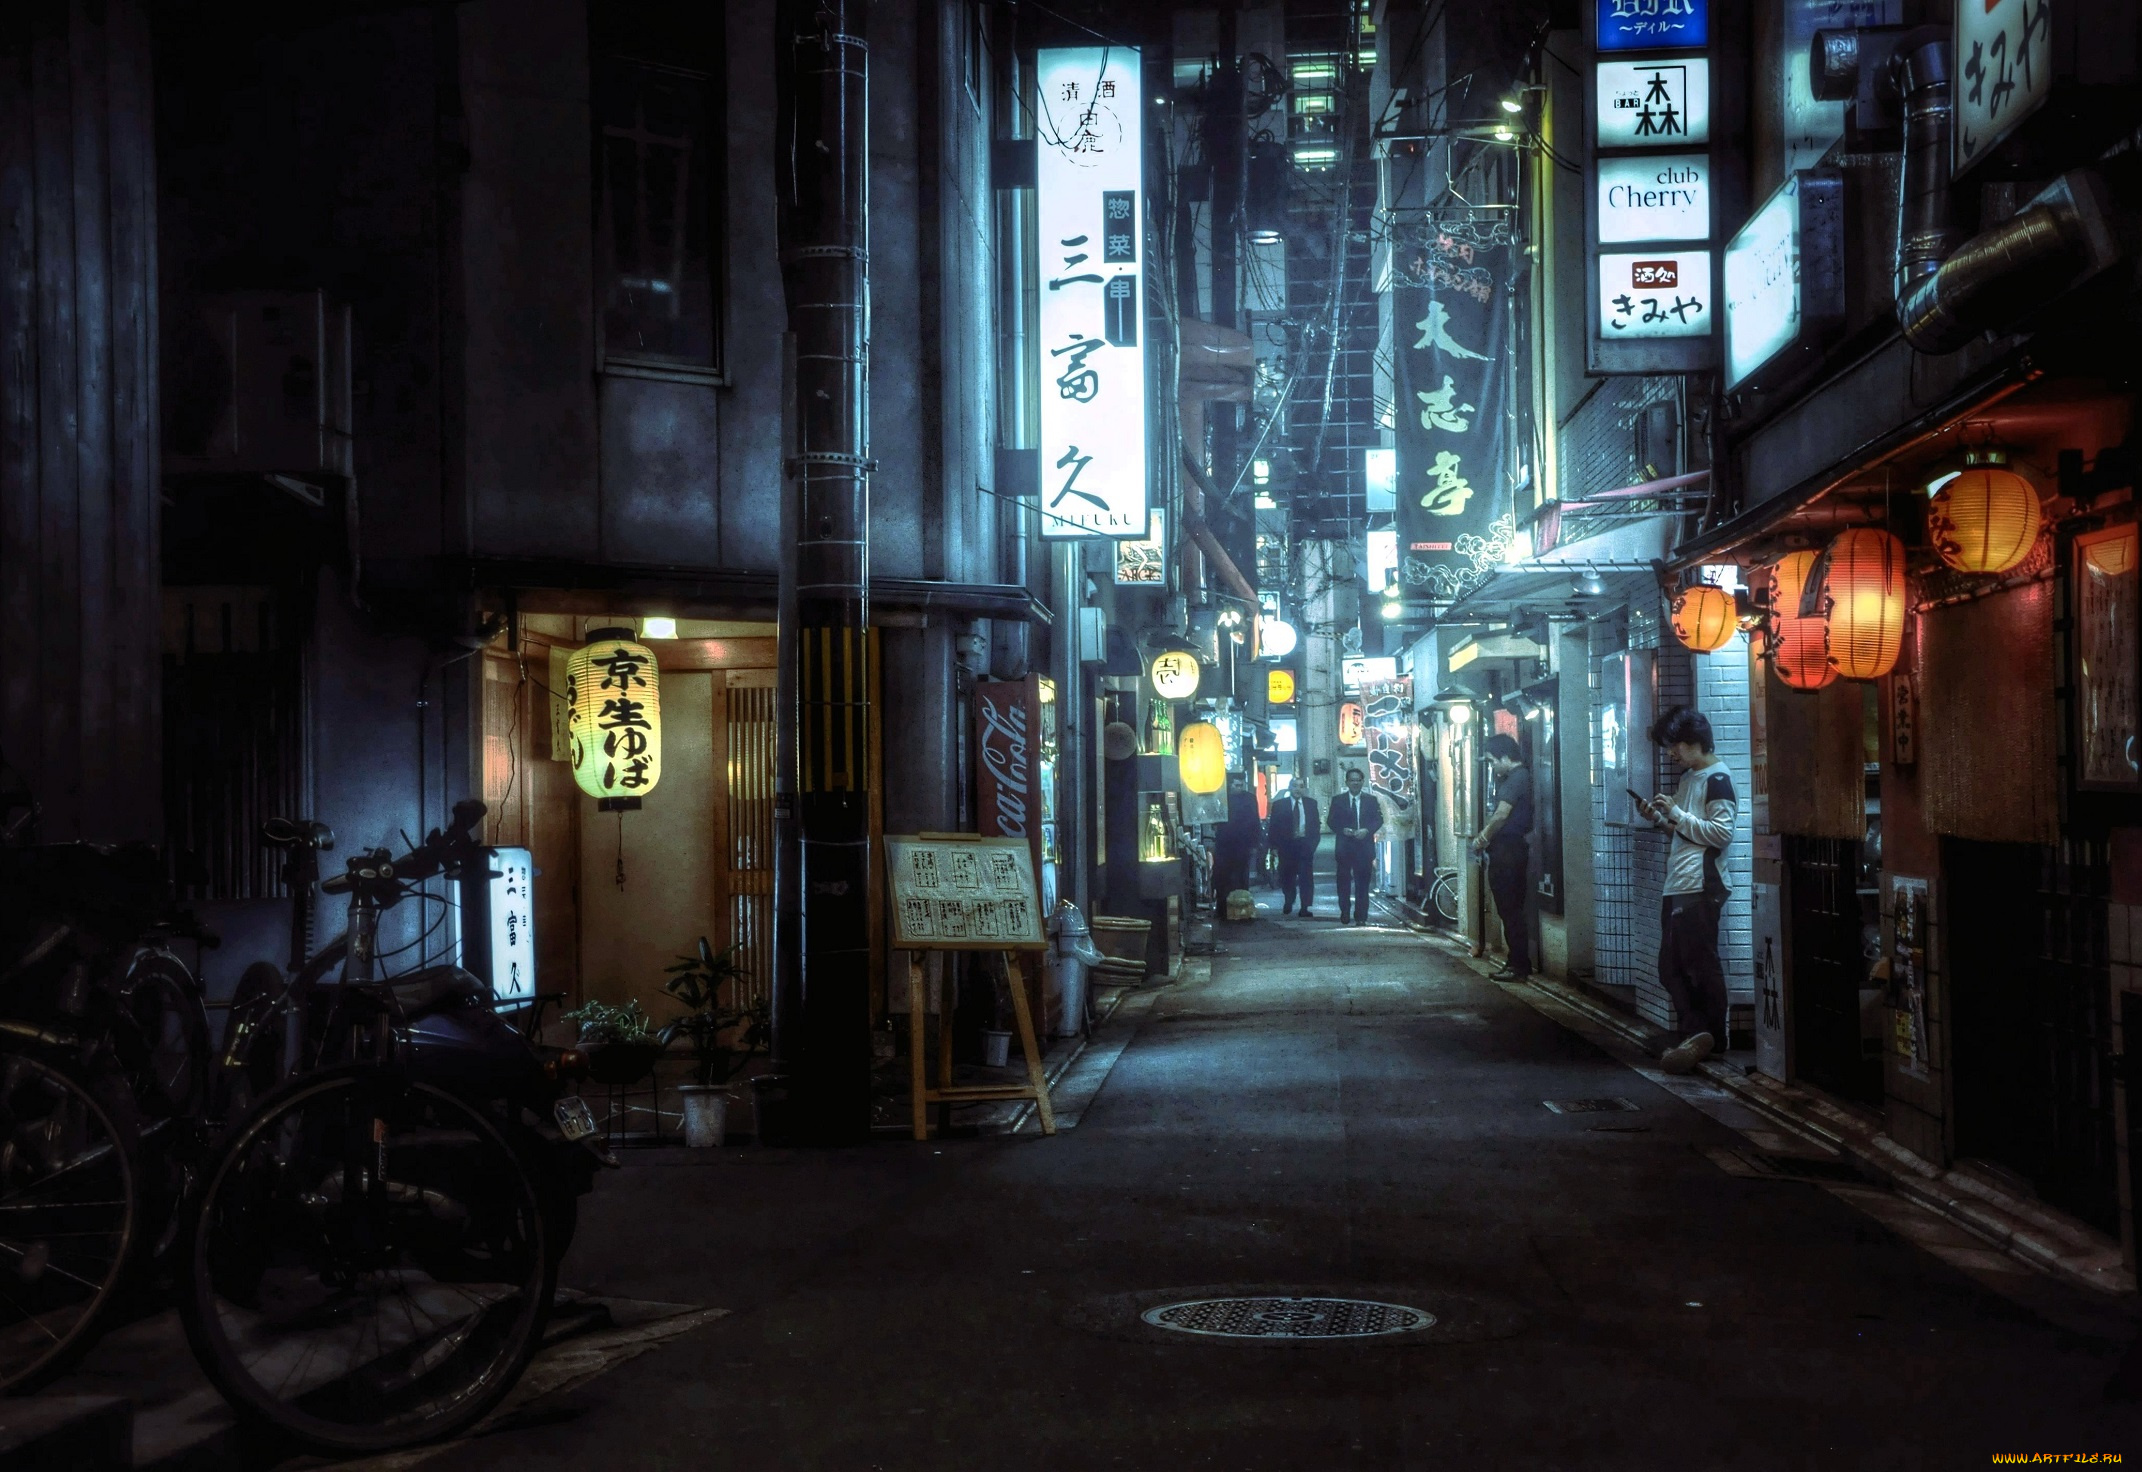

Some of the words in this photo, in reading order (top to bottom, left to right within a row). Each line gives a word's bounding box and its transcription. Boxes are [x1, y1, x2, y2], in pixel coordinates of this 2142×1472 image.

[1615, 98, 1640, 108] BAR
[1635, 72, 1682, 137] 森
[1657, 168, 1699, 184] club
[1608, 186, 1697, 209] Cherry
[1611, 294, 1703, 330] きみや
[1048, 234, 1110, 512] 三富久
